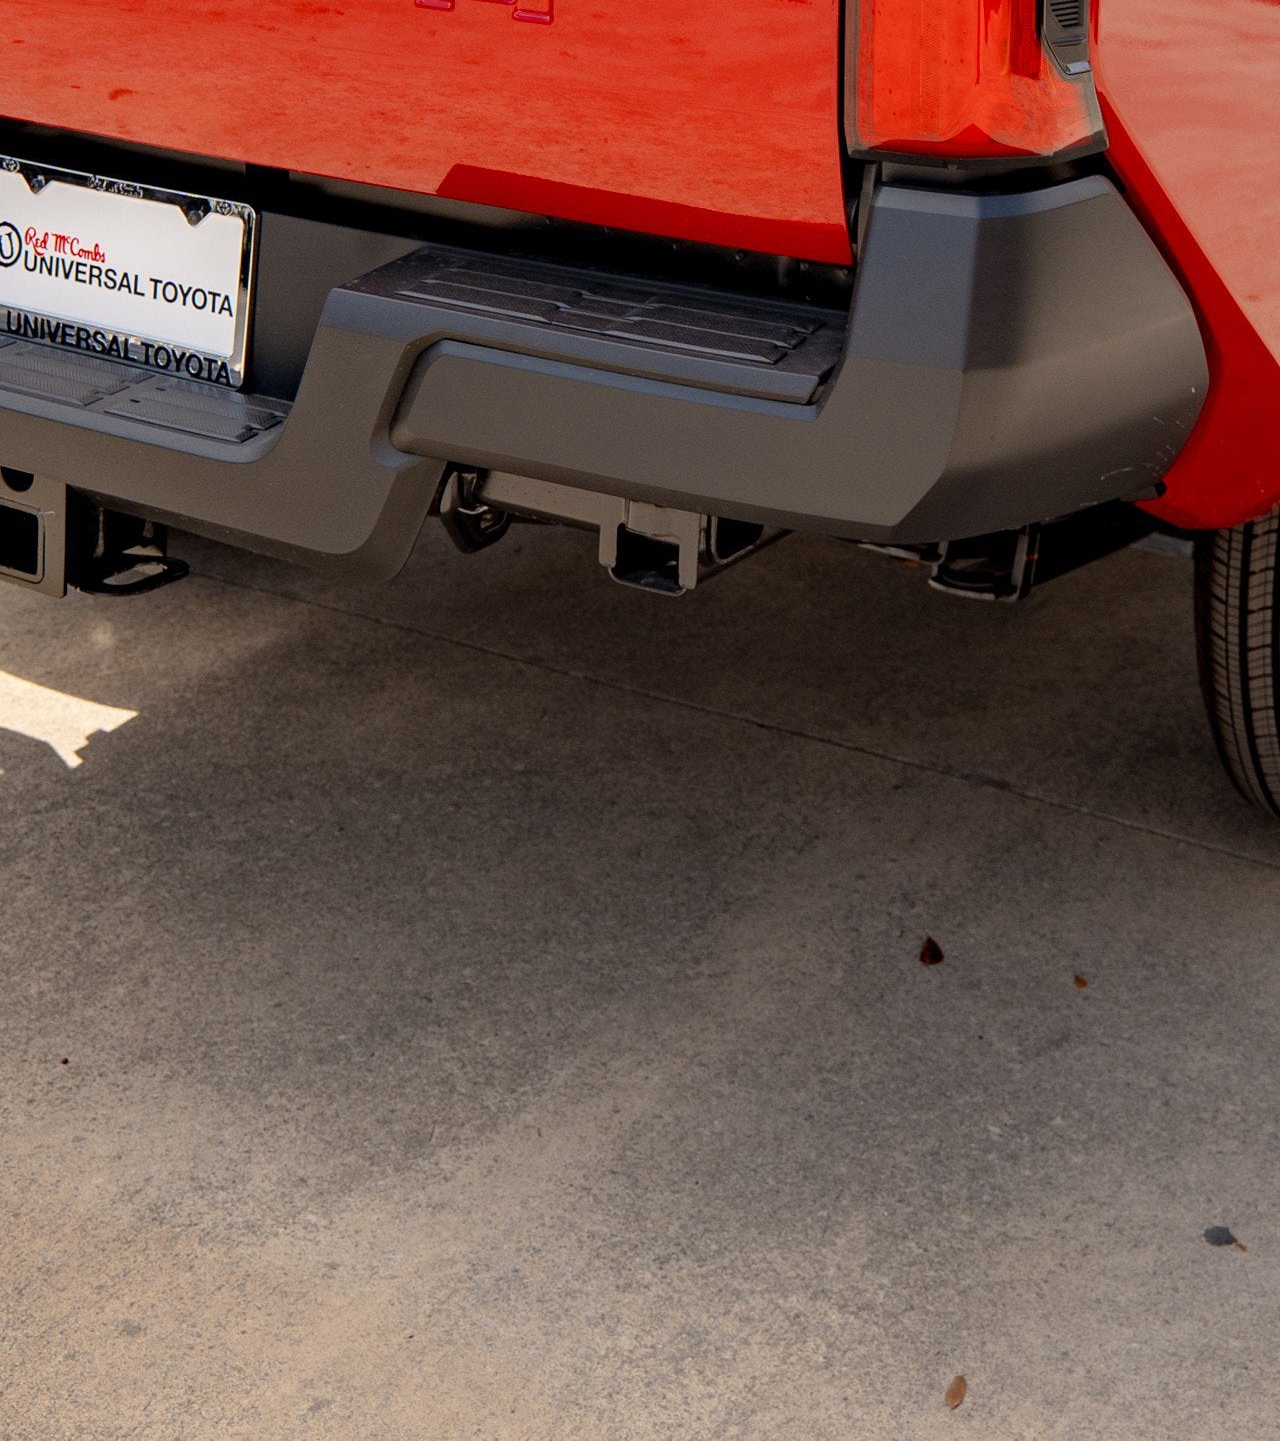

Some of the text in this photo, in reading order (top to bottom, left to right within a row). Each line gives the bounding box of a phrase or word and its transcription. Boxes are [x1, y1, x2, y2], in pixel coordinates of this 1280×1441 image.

[24, 227, 49, 256] Red
[23, 250, 234, 318] UNIVERSAL TOYOTA
[6, 310, 233, 387] UNIVERSAL TOYOTA
